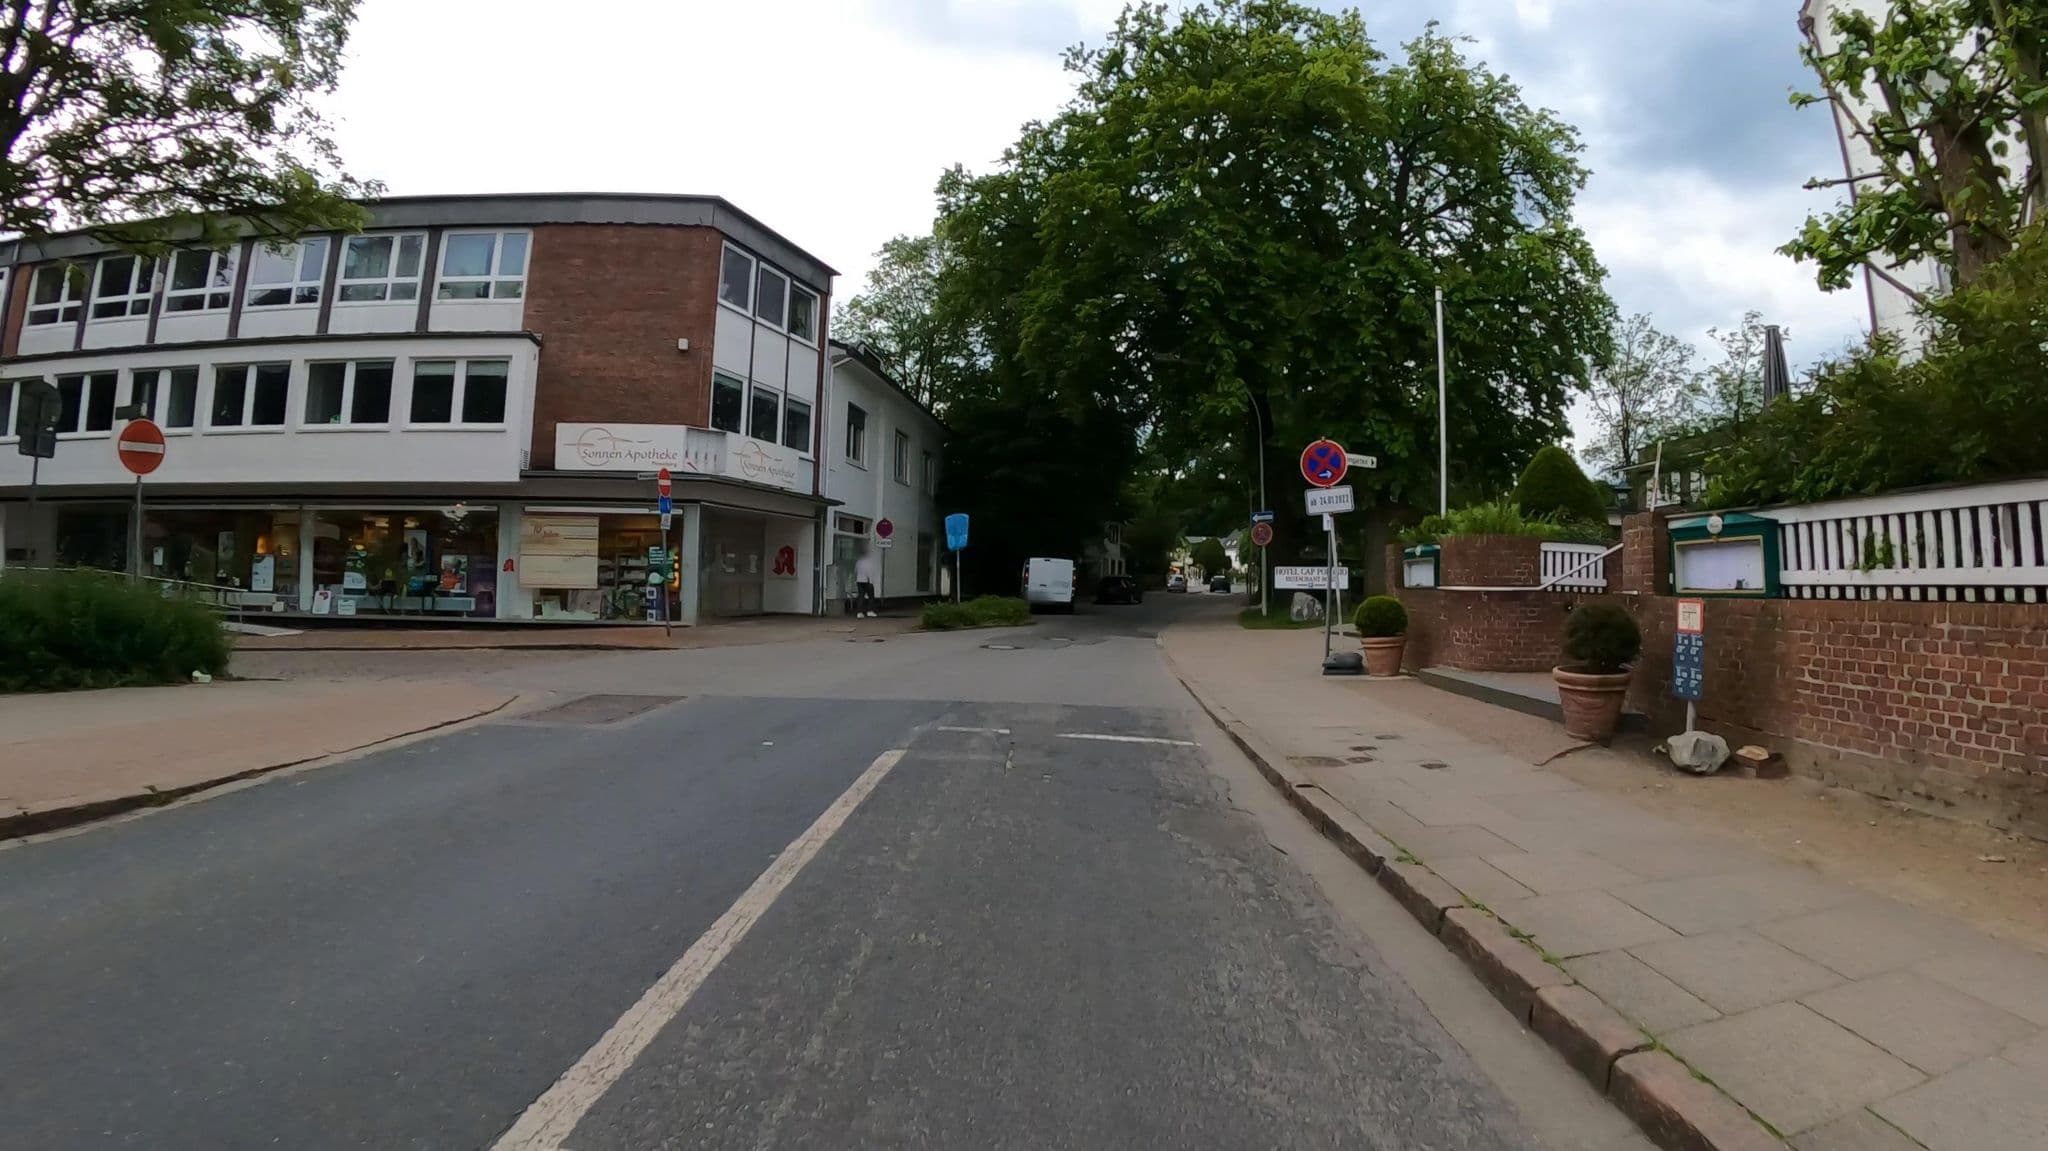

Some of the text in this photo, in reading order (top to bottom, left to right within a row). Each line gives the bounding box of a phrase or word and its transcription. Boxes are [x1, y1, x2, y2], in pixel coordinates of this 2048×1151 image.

[583, 448, 678, 462] Sonnen Apotheke
[1275, 567, 1299, 576] HOTEL
[1301, 567, 1316, 576] CAP
